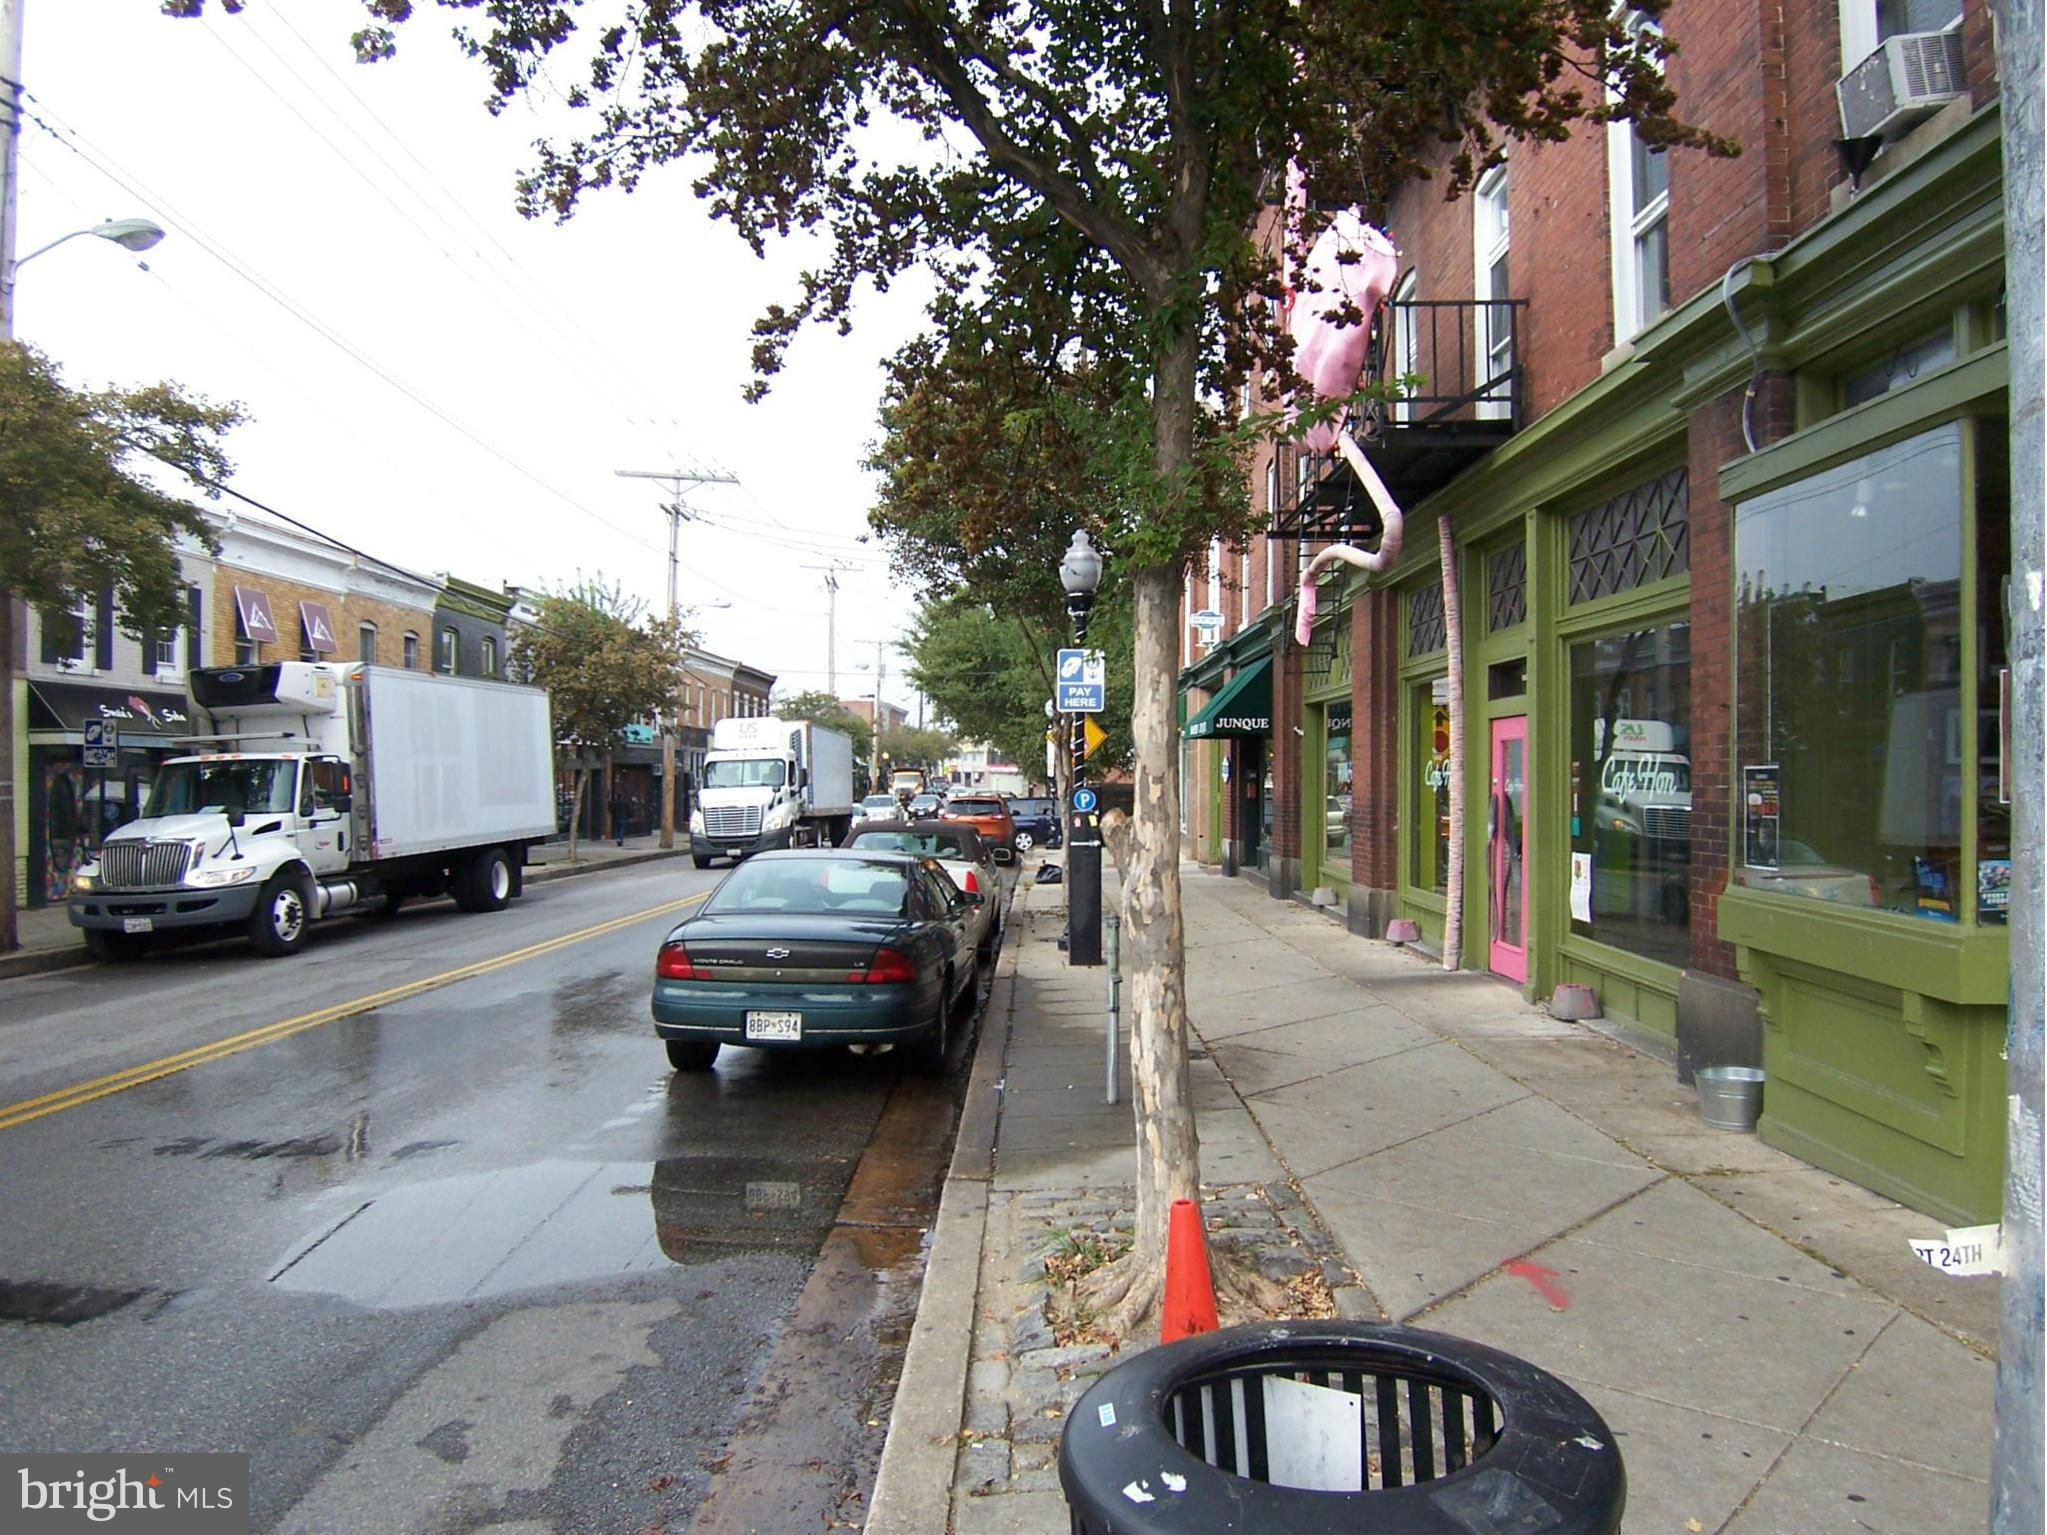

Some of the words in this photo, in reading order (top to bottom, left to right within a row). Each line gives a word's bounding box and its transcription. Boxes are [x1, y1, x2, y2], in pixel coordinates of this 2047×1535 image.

[1069, 687, 1091, 696] PAY
[1064, 697, 1097, 707] HERE
[1216, 717, 1269, 730] JUNQUE
[1601, 755, 1637, 804] Cafe
[1637, 752, 1678, 800] Hon
[1080, 793, 1090, 808] P
[1940, 1244, 1982, 1267] 24TH
